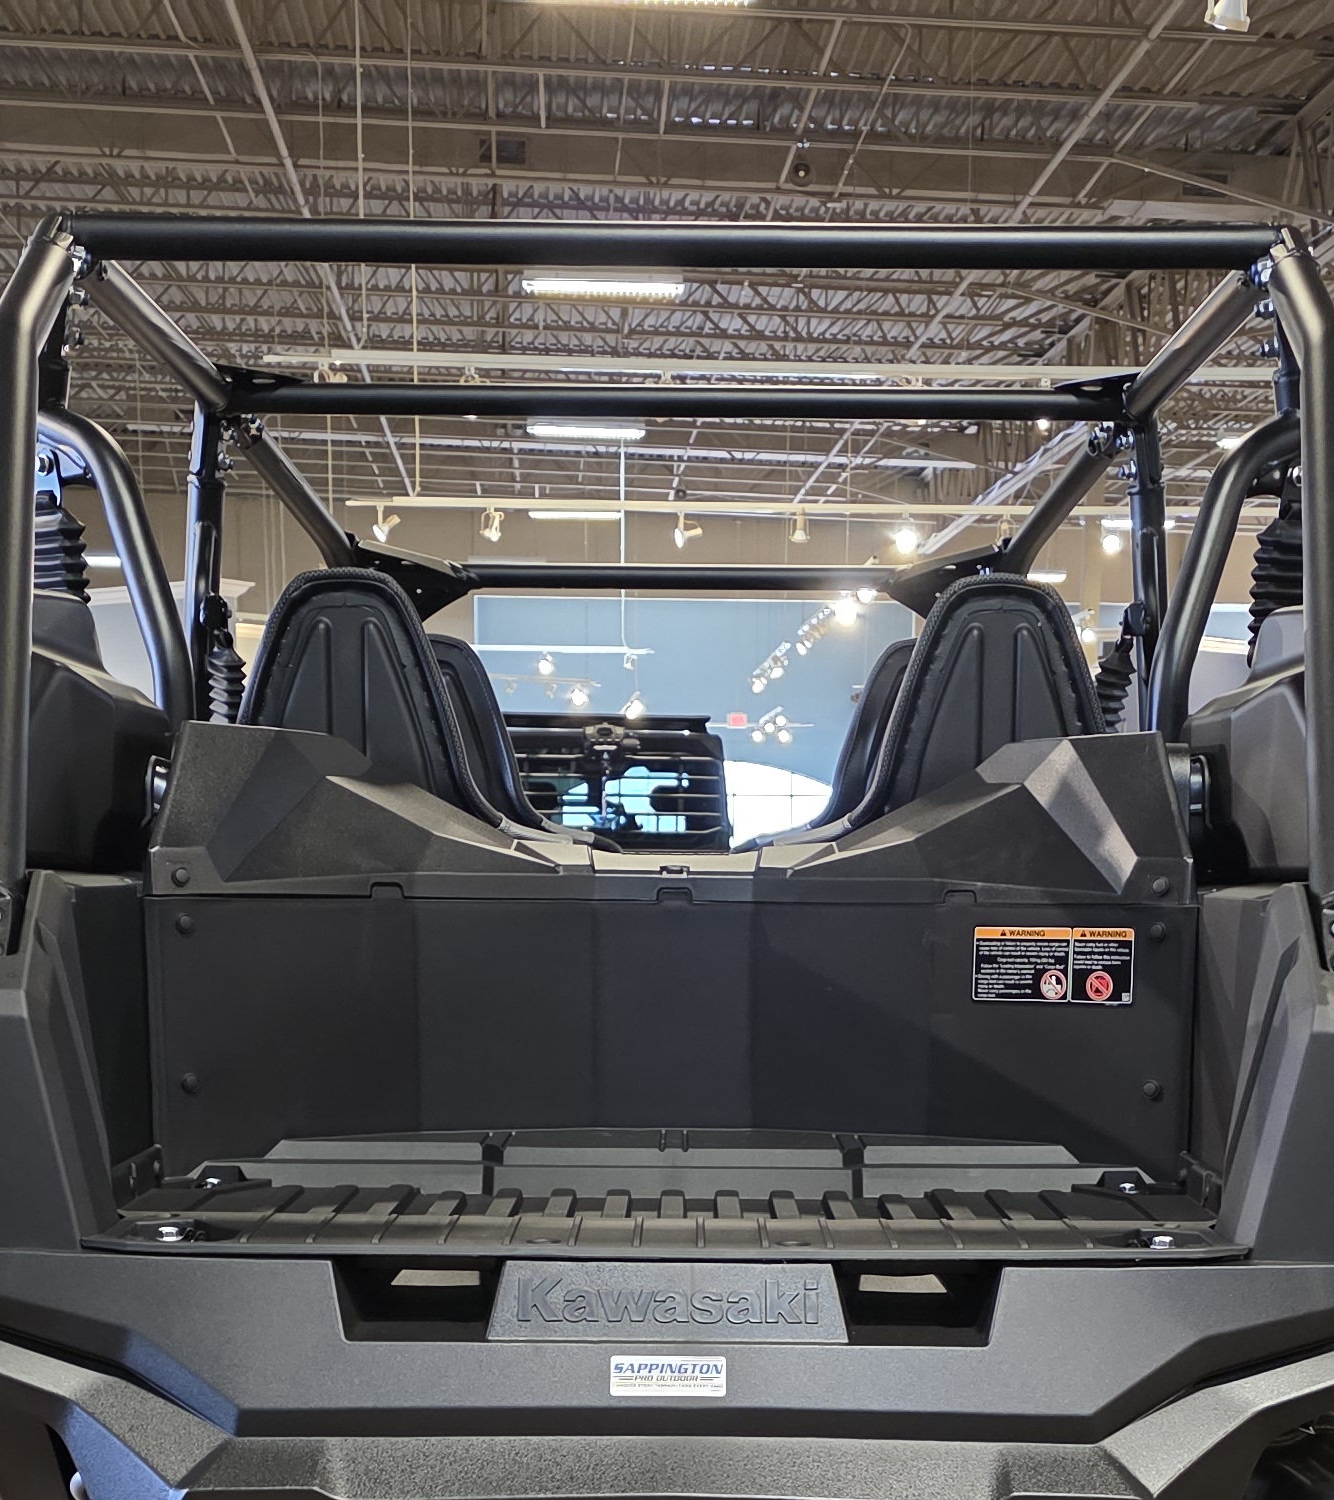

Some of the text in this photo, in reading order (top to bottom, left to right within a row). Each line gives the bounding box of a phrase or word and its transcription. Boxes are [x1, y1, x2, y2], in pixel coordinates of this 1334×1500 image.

[1008, 929, 1046, 938] WARNING
[1088, 930, 1128, 939] WARNING
[516, 1276, 821, 1326] Kawasaki
[612, 1362, 724, 1375] SAPPINGTON
